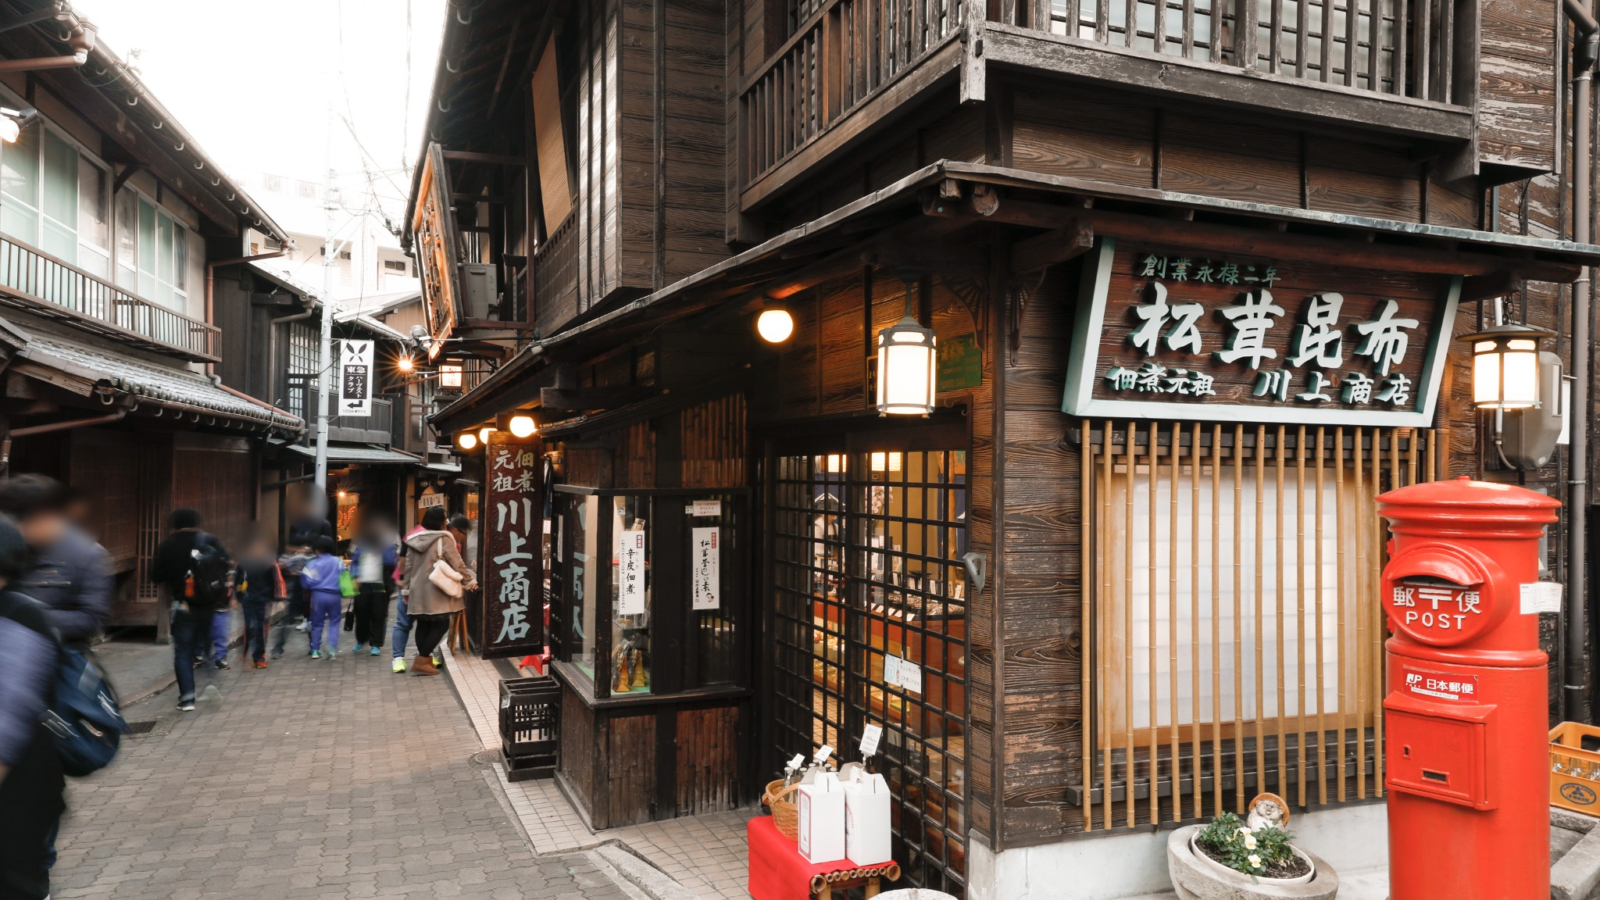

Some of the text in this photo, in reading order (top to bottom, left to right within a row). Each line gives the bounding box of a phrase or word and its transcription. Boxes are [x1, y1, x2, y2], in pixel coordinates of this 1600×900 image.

[1141, 253, 1282, 286] 創業永禄二年
[1130, 281, 1419, 377] 松茸昆布
[1108, 362, 1411, 406] 佃煮元祖 川上商店
[492, 449, 516, 493] 元祖
[514, 449, 536, 493] 佃煮
[493, 497, 533, 644] 川上商店
[1406, 611, 1466, 630] POST
[1426, 678, 1474, 694] 日本郵便
